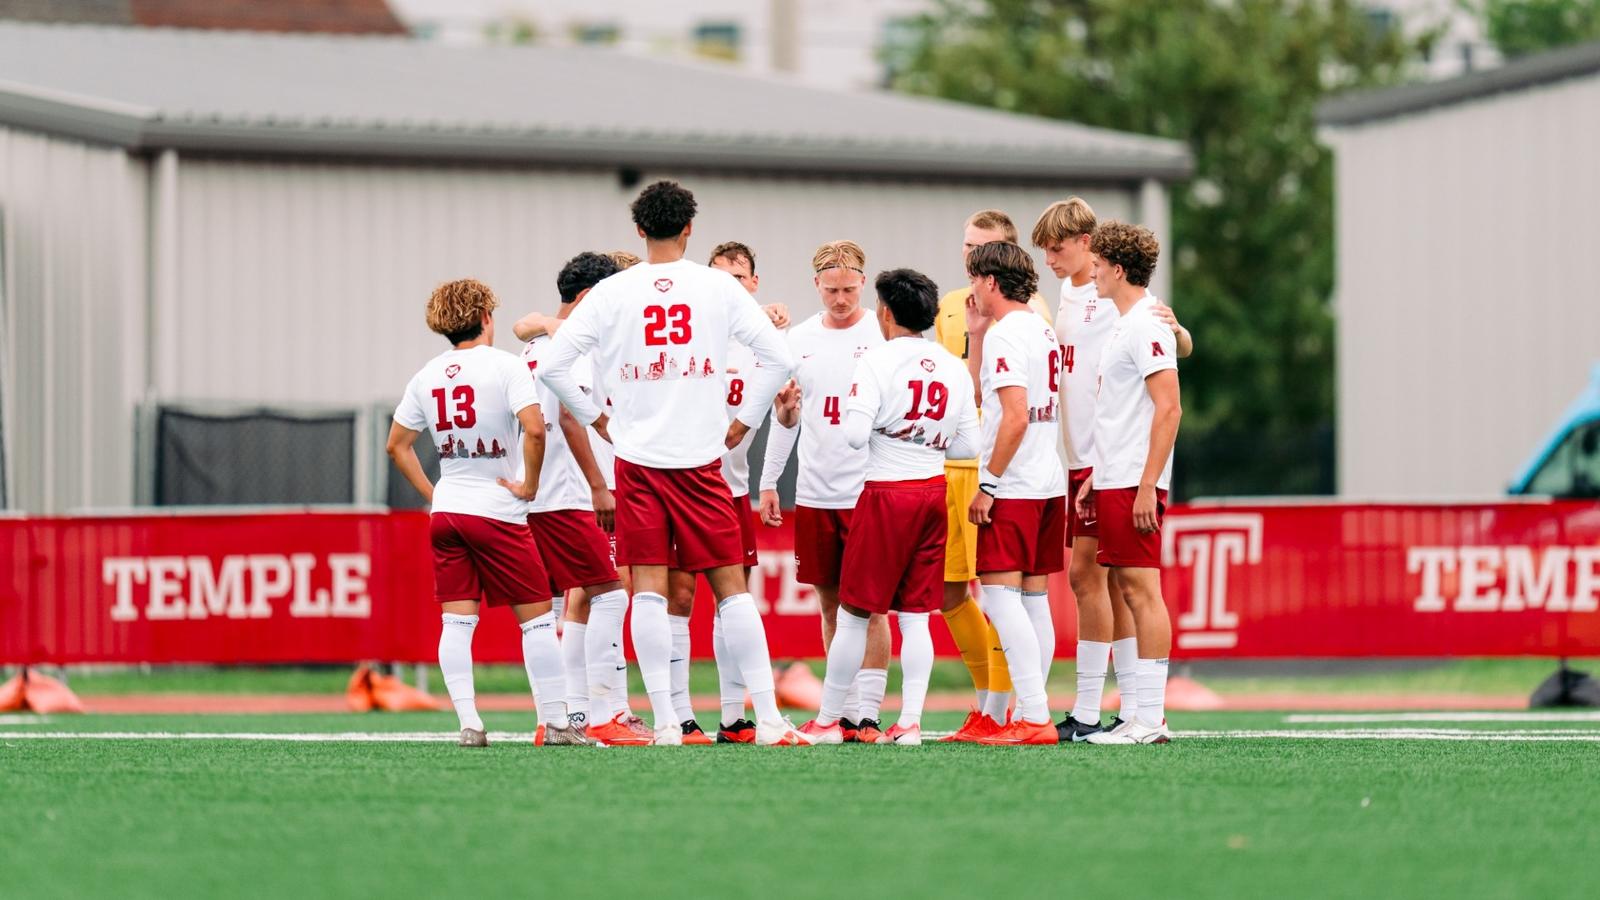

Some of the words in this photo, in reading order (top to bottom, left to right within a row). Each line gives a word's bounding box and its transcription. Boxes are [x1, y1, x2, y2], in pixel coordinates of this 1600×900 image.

[643, 304, 692, 346] 23
[727, 378, 744, 406] 8
[1048, 350, 1060, 392] 6
[431, 385, 477, 432] 13
[823, 396, 841, 425] 4
[903, 380, 949, 422] 19
[102, 552, 372, 621] TEMPLE
[1406, 545, 1600, 613] TEMP
